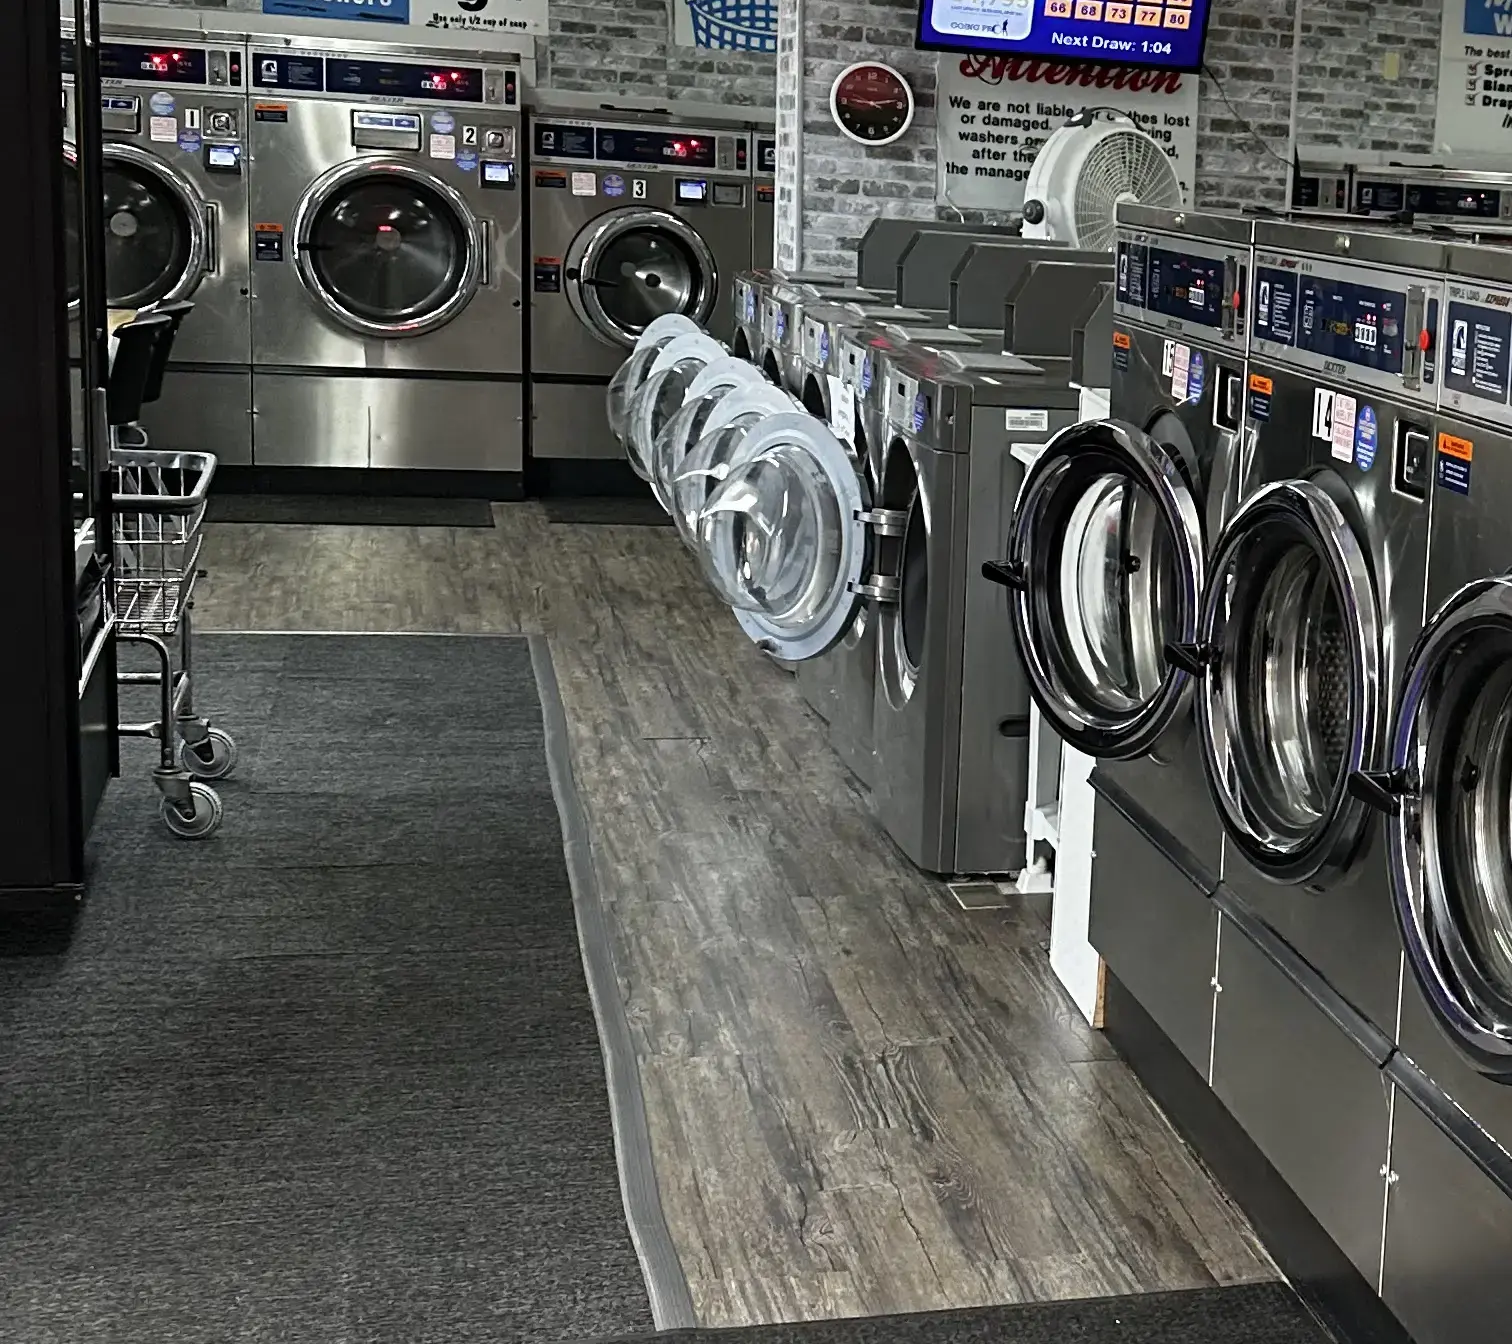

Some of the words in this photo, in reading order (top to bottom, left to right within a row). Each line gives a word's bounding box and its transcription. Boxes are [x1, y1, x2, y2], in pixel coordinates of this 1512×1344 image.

[1050, 2, 1067, 14] 66
[1081, 5, 1097, 17] 68
[1111, 8, 1127, 20] 73
[1140, 11, 1157, 23] 77
[1169, 14, 1186, 26] 80
[1051, 31, 1089, 47] Next
[1091, 36, 1136, 52] Draw:
[1141, 40, 1172, 55] 1:04
[1465, 45, 1484, 57] The
[1487, 47, 1511, 60] best
[949, 94, 971, 110] We
[978, 100, 1001, 112] are
[1007, 102, 1031, 114] not
[1036, 102, 1074, 118] liable
[1164, 113, 1190, 127] lost
[960, 114, 976, 125] or
[982, 113, 1053, 132] damaged.
[465, 127, 475, 145] 2
[958, 130, 1019, 145] washers
[972, 147, 1007, 161] after
[946, 162, 969, 175] the
[975, 166, 1031, 181] manage
[635, 181, 644, 198] 3
[1316, 392, 1333, 438] 14
